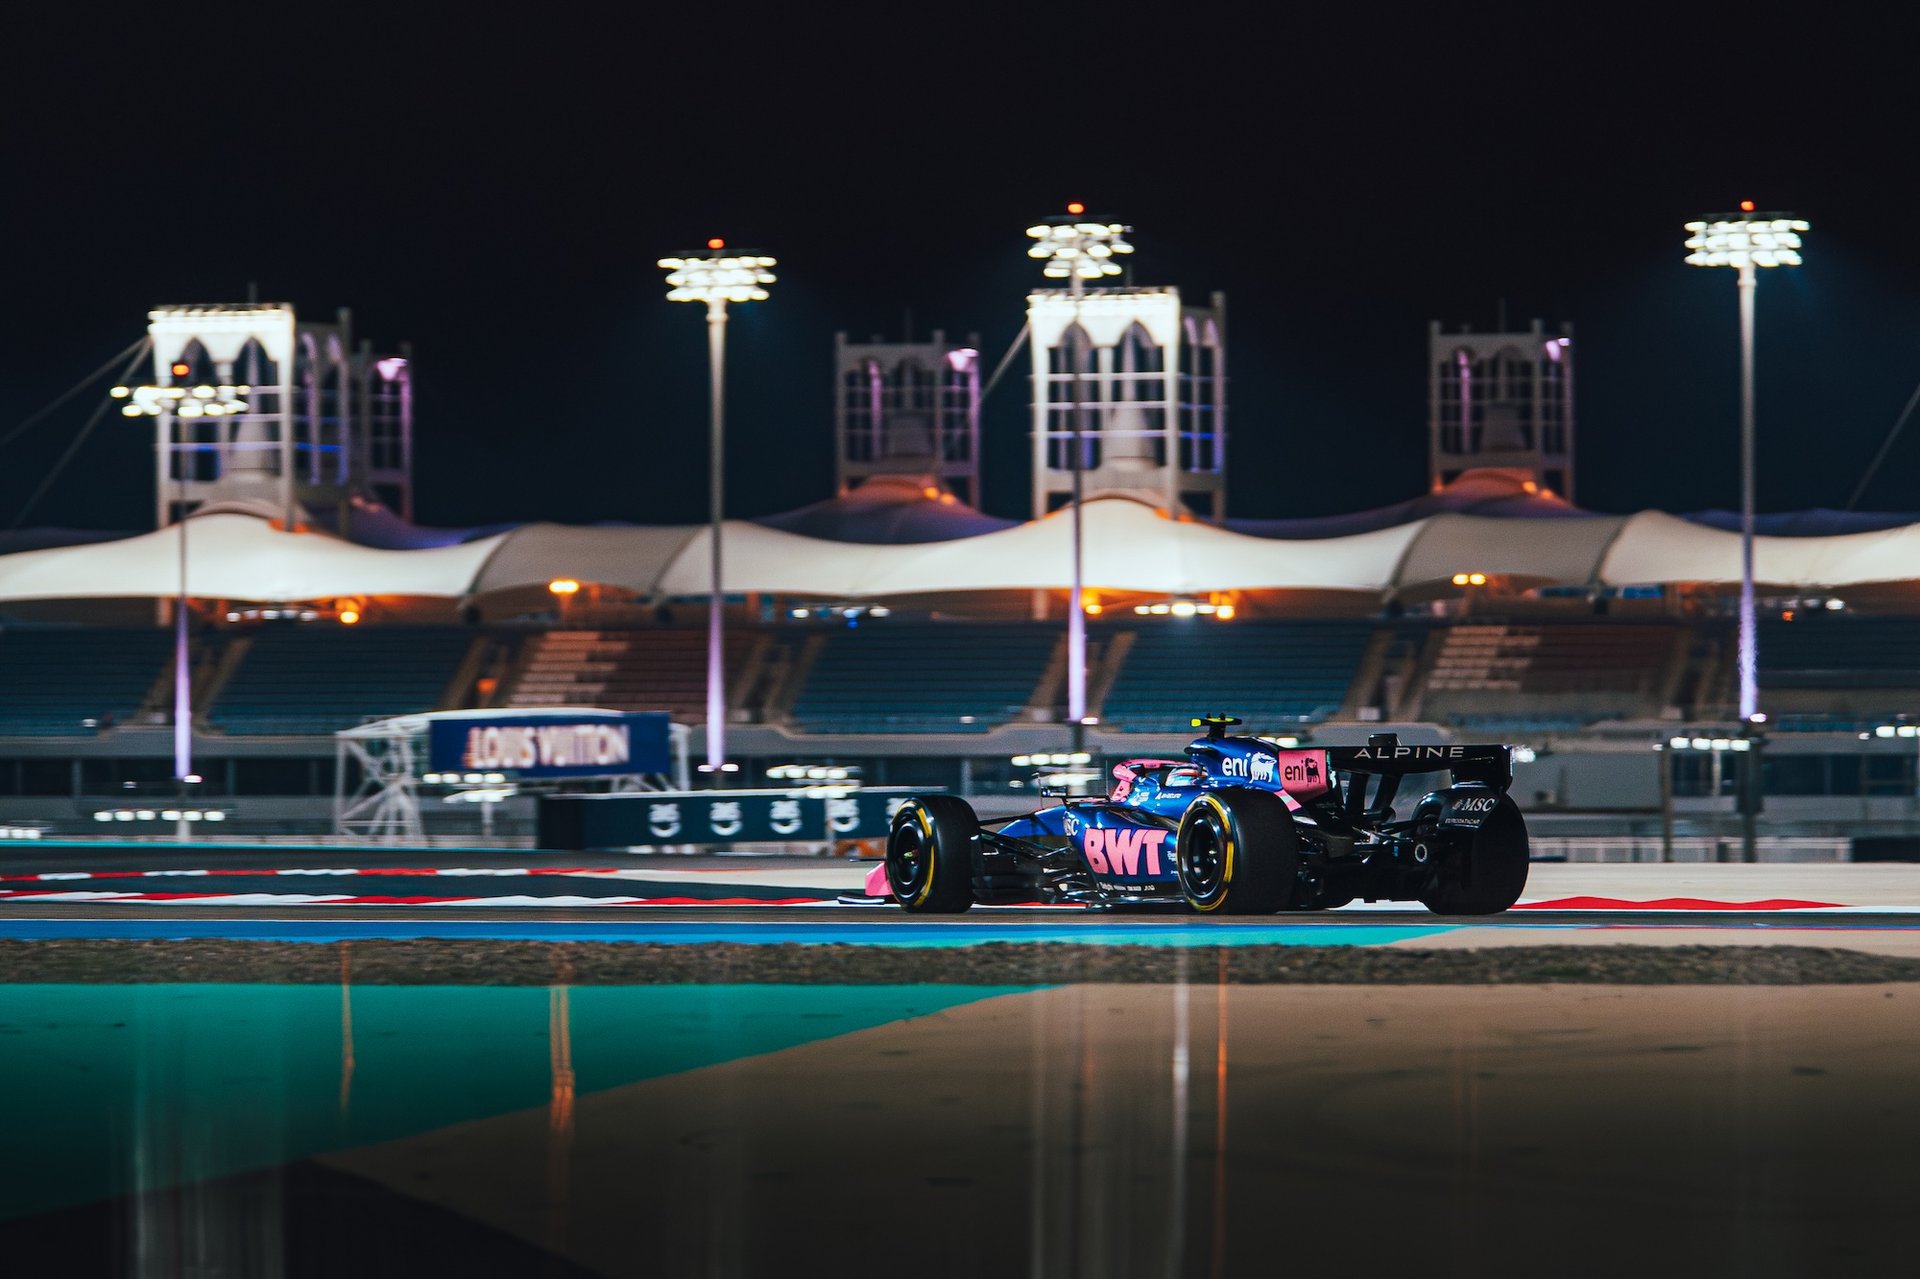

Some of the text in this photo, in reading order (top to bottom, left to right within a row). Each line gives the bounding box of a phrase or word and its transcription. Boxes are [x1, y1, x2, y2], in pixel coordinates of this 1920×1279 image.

[1353, 746, 1465, 759] ALPINE
[1222, 752, 1252, 777] eni
[1284, 759, 1305, 781] eni
[1461, 797, 1496, 812] MSC
[1083, 828, 1169, 876] BWT
